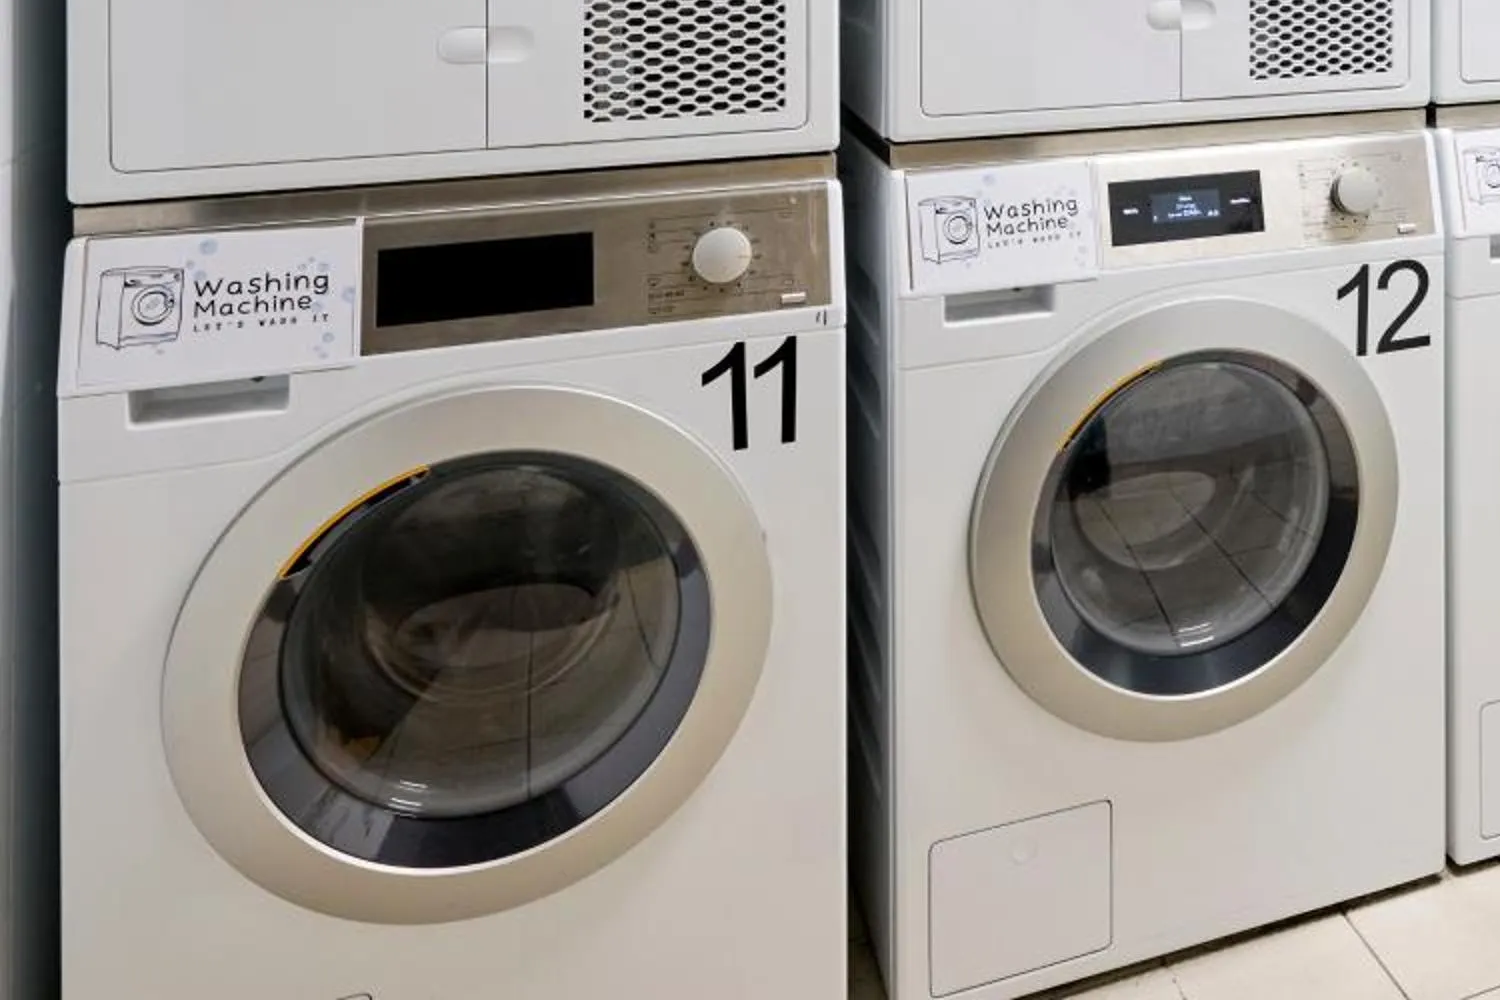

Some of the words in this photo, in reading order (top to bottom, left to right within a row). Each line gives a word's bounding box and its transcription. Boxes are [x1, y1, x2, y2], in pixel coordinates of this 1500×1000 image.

[984, 199, 1079, 220] Washing
[987, 214, 1069, 237] Machine
[194, 271, 329, 297] Washing
[193, 295, 312, 318] Machine
[1337, 259, 1430, 356] 12
[702, 335, 797, 451] 11
